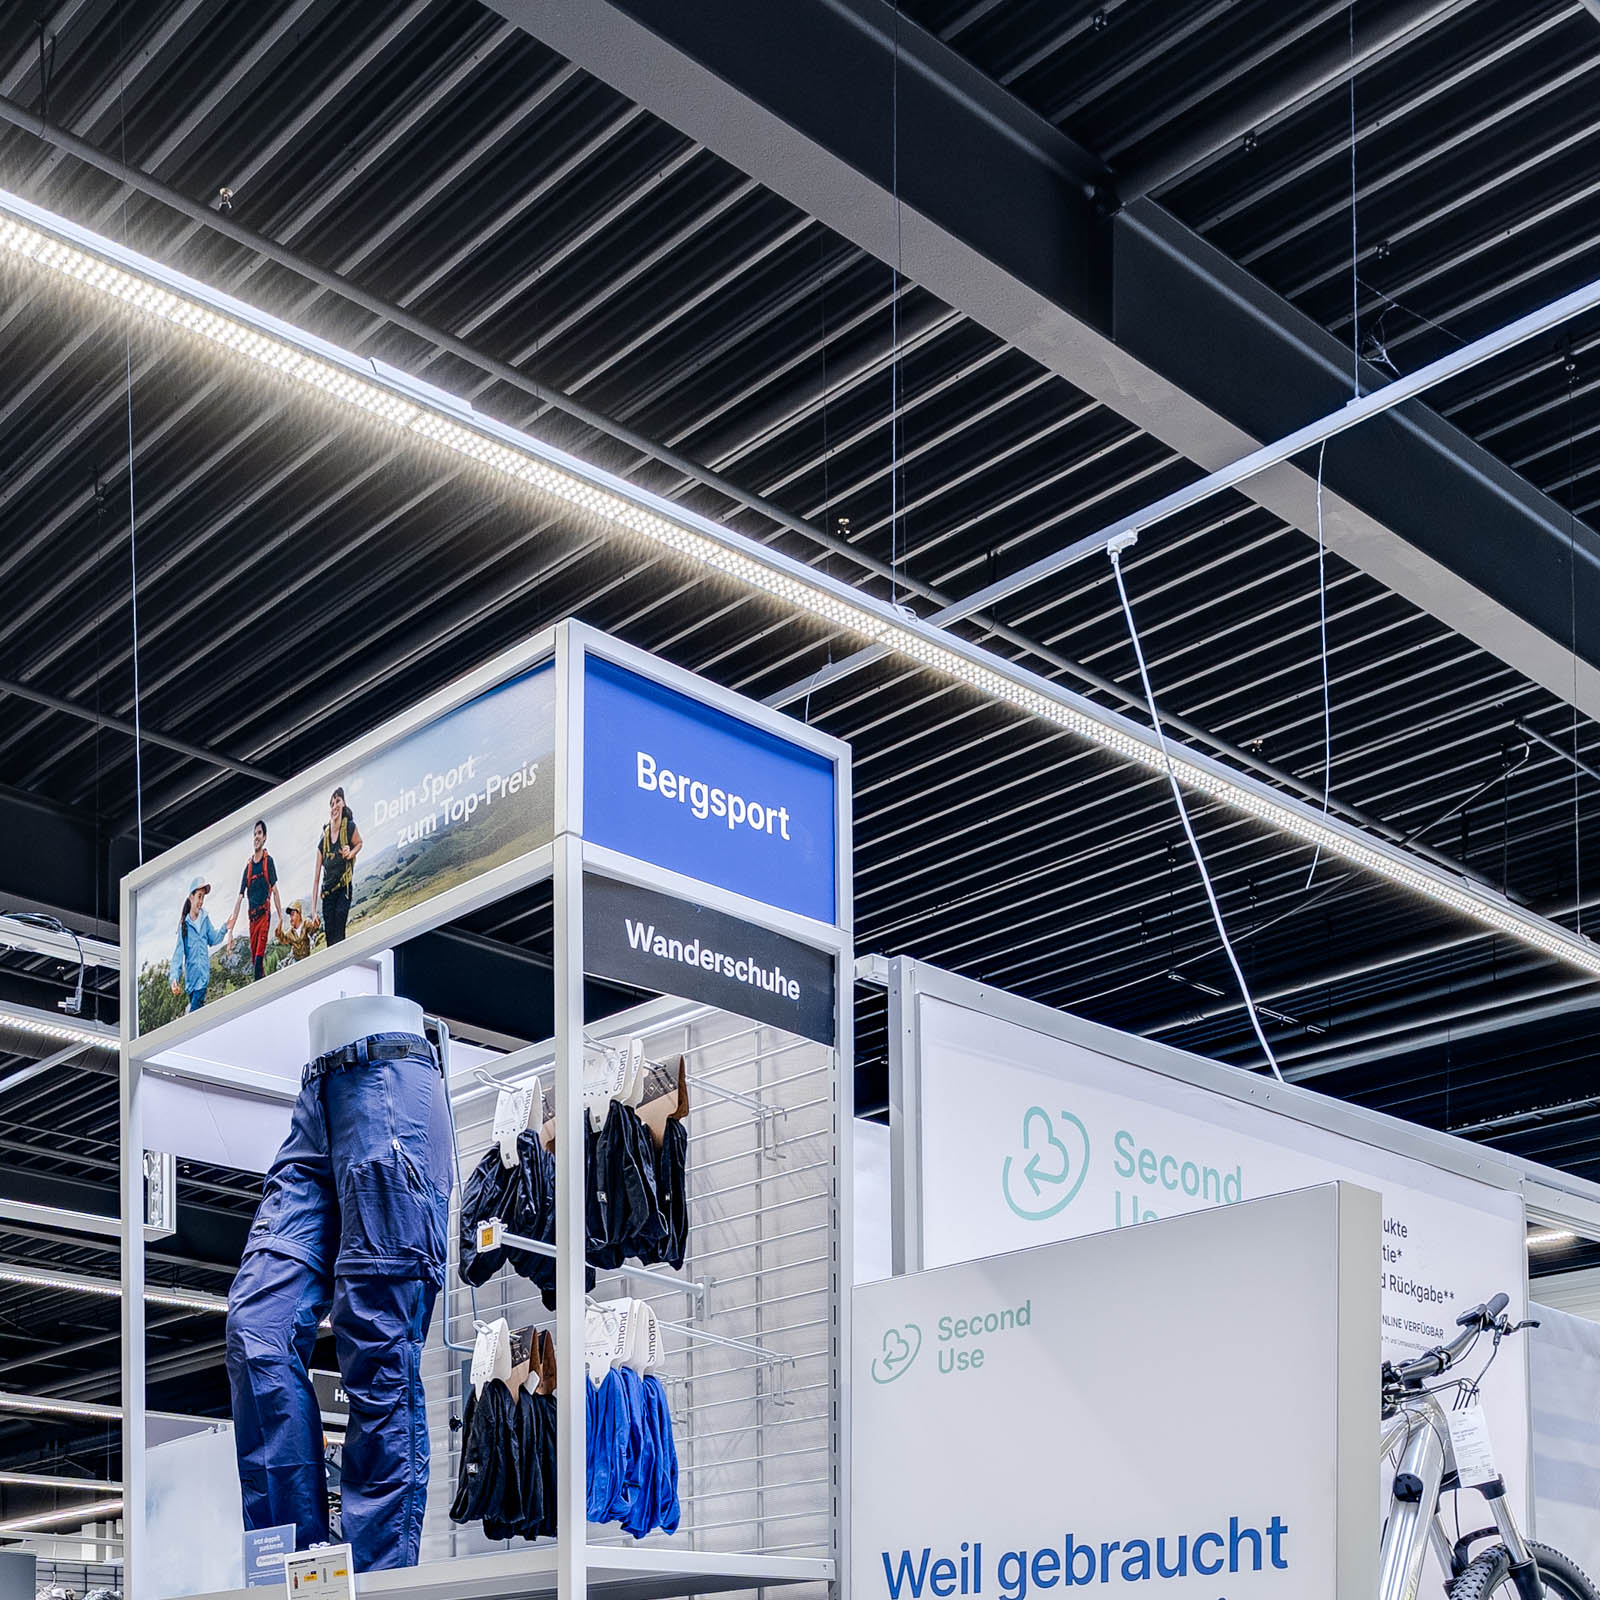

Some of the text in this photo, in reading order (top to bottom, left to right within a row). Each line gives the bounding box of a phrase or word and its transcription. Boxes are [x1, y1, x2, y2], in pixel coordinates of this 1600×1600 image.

[374, 755, 476, 826] Dein Sport
[397, 761, 539, 848] zum Top-Preis
[636, 751, 791, 840] Bergsport
[624, 918, 801, 1000] Wanderschuhe
[613, 1049, 628, 1094] Simond
[1114, 1130, 1242, 1203] Second
[1383, 1217, 1408, 1238] ukte
[614, 1311, 628, 1355] Simond
[937, 1300, 1031, 1341] Second
[1382, 1314, 1402, 1330] NLINE
[938, 1347, 985, 1374] Use
[335, 1388, 350, 1403] He
[881, 1542, 982, 1600] Weil
